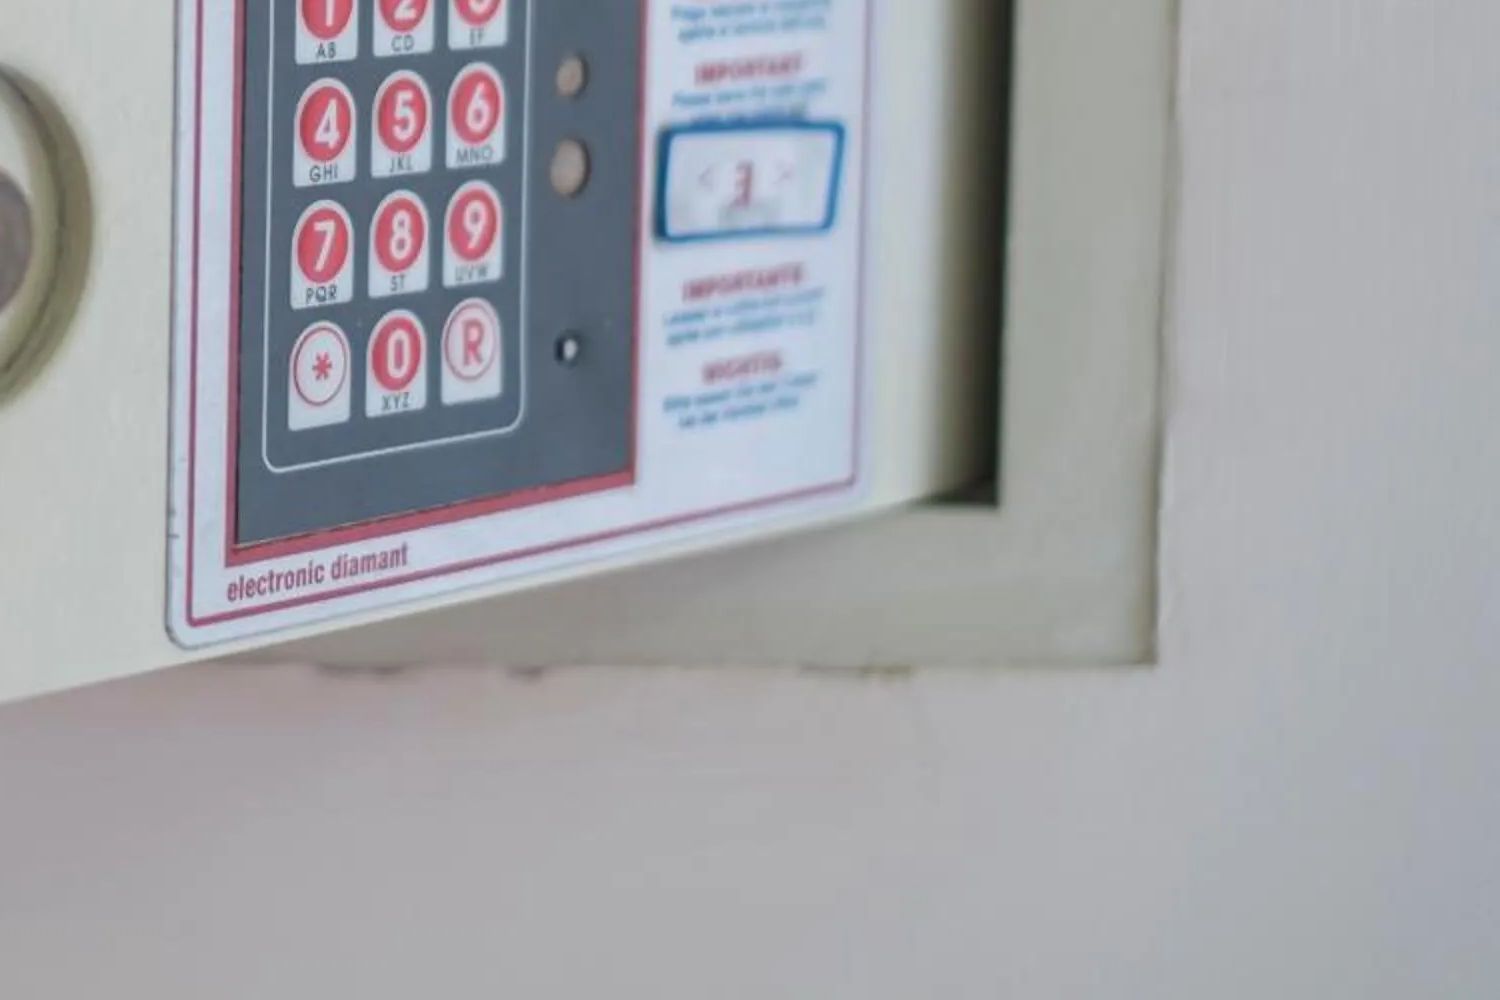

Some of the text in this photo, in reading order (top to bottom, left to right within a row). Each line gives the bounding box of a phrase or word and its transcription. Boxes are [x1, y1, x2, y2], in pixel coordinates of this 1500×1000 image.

[315, 28, 487, 60] AB CD EF
[314, 81, 490, 149] 4 5 6
[309, 145, 494, 183] GHI JKL MNO
[313, 200, 489, 273] 7 8 9
[305, 263, 490, 305] PQR ST UVW
[386, 327, 411, 380] 0
[461, 317, 485, 368] R
[381, 391, 411, 412] XYZ
[226, 541, 409, 603] electronic diamant
